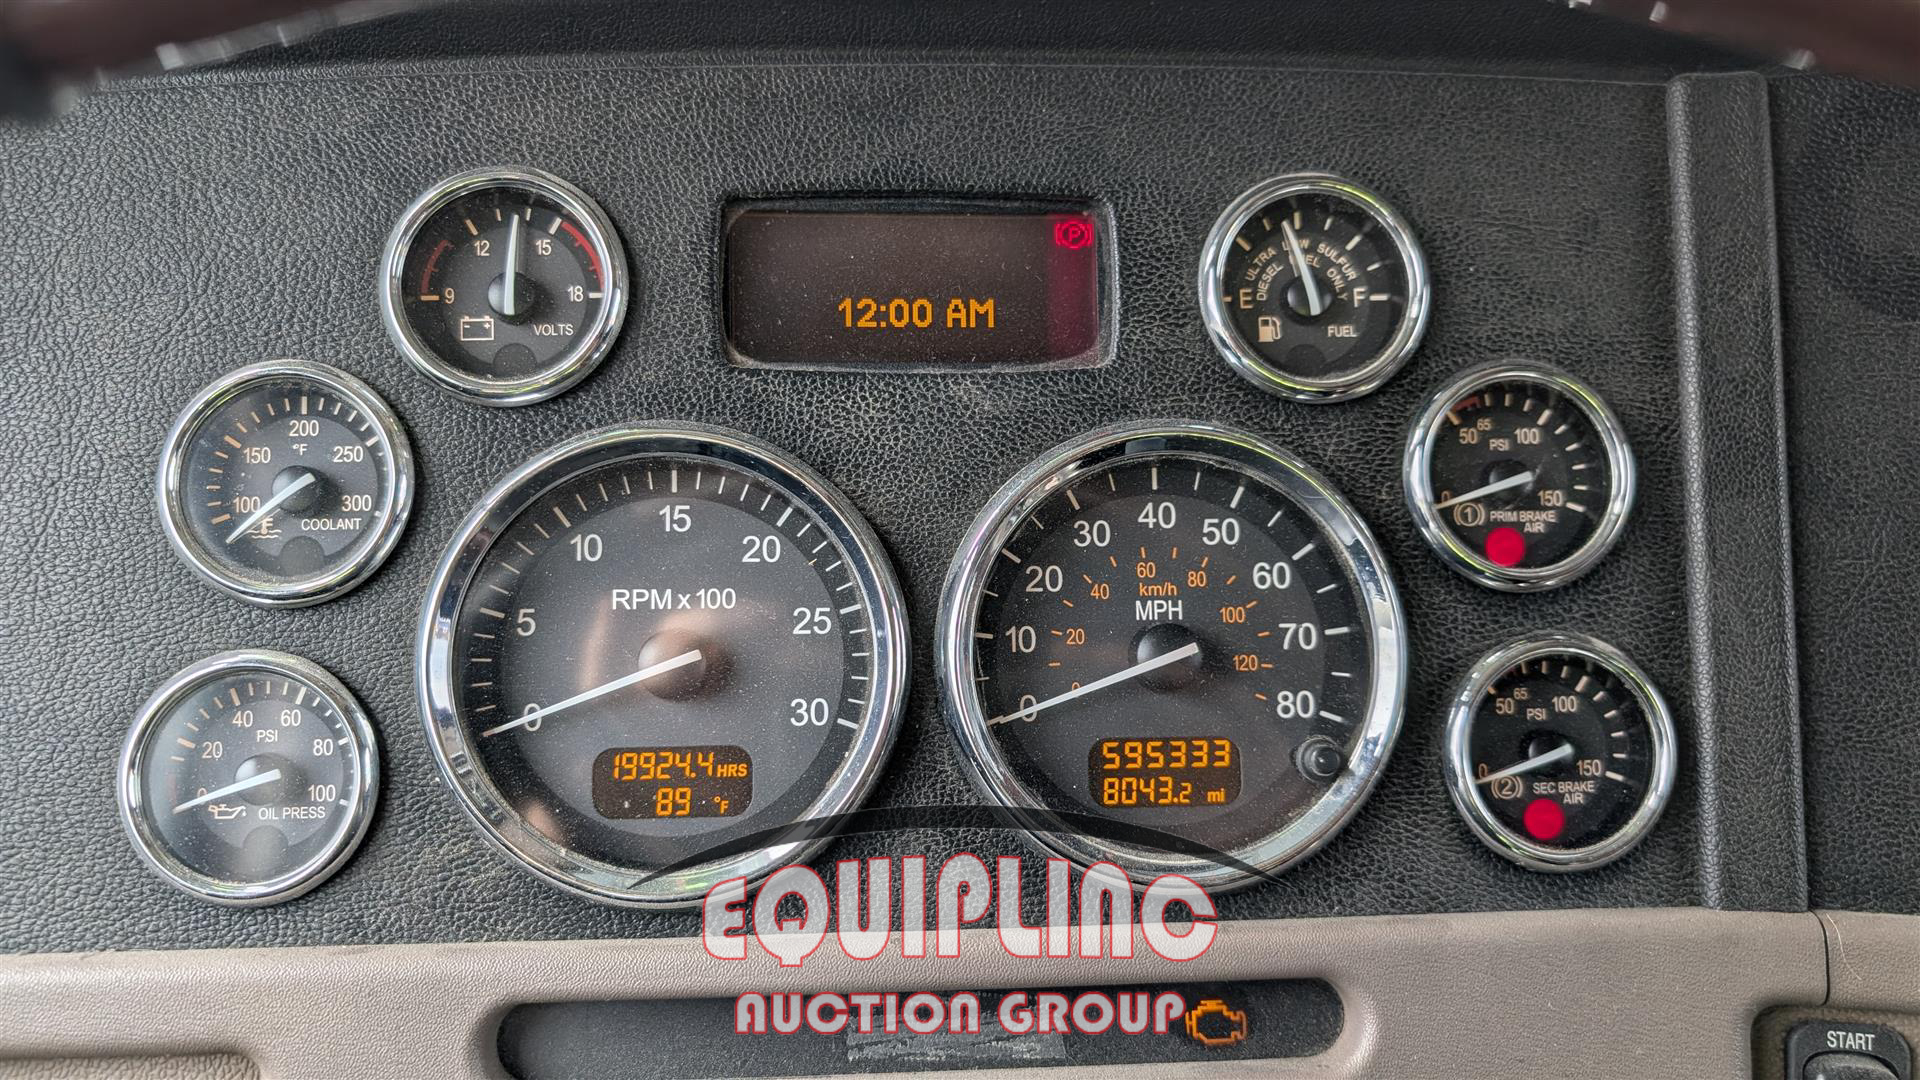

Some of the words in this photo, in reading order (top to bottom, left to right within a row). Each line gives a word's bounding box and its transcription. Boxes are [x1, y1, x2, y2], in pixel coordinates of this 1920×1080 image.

[474, 241, 490, 257] 12
[535, 239, 552, 255] 15
[1245, 247, 1277, 281] ULTRA
[1282, 238, 1310, 251] LW
[1317, 243, 1357, 281] SULFUR
[1256, 262, 1284, 301] DIESEL
[1326, 268, 1348, 301] ONLY
[445, 288, 455, 304] 9
[567, 285, 583, 302] 18
[1240, 288, 1254, 309] E
[1354, 287, 1367, 307] F
[838, 298, 933, 328] 12:00
[946, 298, 995, 328] AM
[534, 324, 574, 336] VOLTS
[1327, 325, 1359, 338] FUEL
[289, 420, 320, 437] 200
[1477, 418, 1491, 431] 65
[1459, 429, 1478, 444] 50
[1514, 429, 1540, 445] 100
[1489, 439, 1510, 452] PSI
[243, 447, 271, 464] 150
[333, 446, 364, 463] 250
[233, 496, 261, 513] 100
[341, 495, 372, 512] 300
[1538, 490, 1563, 507] 150
[659, 505, 692, 532] 15
[1138, 502, 1176, 529] 40
[1490, 510, 1518, 522] PRIM
[1519, 510, 1557, 522] BRAKE
[301, 518, 362, 531] COOLANT
[1202, 518, 1240, 545] 50
[1524, 522, 1545, 533] AIR
[1073, 520, 1111, 547] 30
[570, 534, 603, 561] 10
[742, 535, 781, 563] 20
[1025, 565, 1063, 592] 20
[1136, 562, 1156, 579] 60
[1187, 570, 1206, 588] 80
[1252, 562, 1291, 589] 60
[1090, 583, 1110, 600] 40
[1139, 582, 1178, 597] km/h
[612, 589, 672, 610] RPM
[677, 594, 691, 609] x
[697, 588, 737, 609] 100
[1135, 600, 1183, 620] MPH
[1219, 606, 1245, 624] 100
[516, 608, 536, 636] 5
[792, 607, 832, 634] 25
[1005, 625, 1036, 653] 10
[1066, 628, 1085, 645] 20
[1279, 623, 1317, 650] 70
[1233, 654, 1258, 671] 120
[1513, 688, 1528, 700] 65
[1020, 694, 1038, 722] 0
[1276, 690, 1315, 718] 80
[1496, 698, 1514, 714] 50
[1552, 696, 1577, 712] 100
[233, 711, 253, 727] 40
[280, 710, 301, 726] 60
[523, 703, 542, 731] 0
[790, 699, 829, 727] 30
[1526, 709, 1547, 721] PSI
[256, 730, 278, 742] PSI
[202, 741, 223, 759] 20
[313, 739, 333, 756] 80
[1103, 740, 1231, 769] 595333
[613, 751, 715, 780] 19924.4
[716, 763, 748, 778] HRS
[1577, 760, 1602, 776] 150
[308, 785, 336, 802] 100
[1103, 776, 1192, 804] 8043.2
[1207, 788, 1225, 803] mi
[1532, 782, 1556, 795] SEC
[1558, 781, 1595, 793] BRAKE
[656, 787, 692, 816] 89
[1563, 793, 1584, 804] AIR
[258, 807, 279, 820] OIL
[282, 806, 326, 819] PRESS
[1827, 1030, 1876, 1051] START
